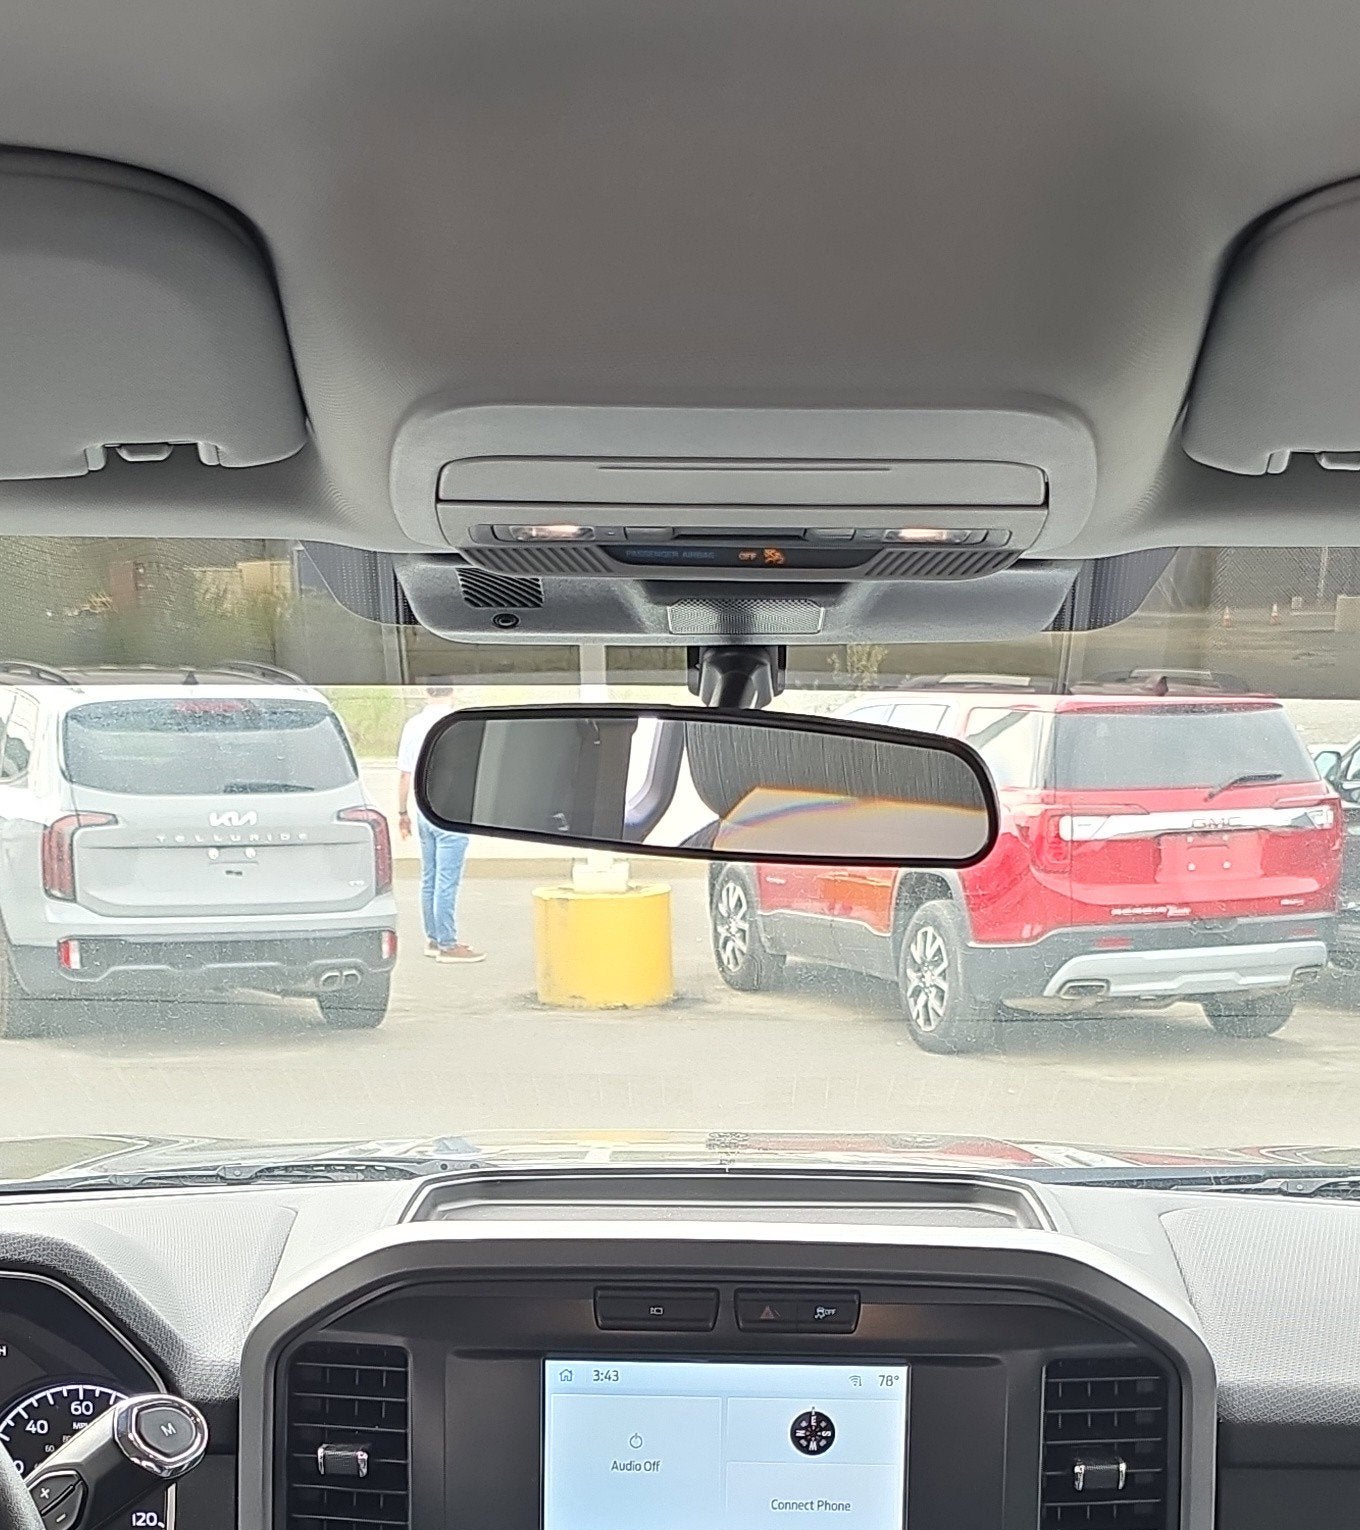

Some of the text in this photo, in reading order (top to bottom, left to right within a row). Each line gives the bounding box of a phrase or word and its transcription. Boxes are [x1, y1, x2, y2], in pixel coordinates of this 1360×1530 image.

[625, 550, 715, 559] PASSENGER AIRBAG
[738, 552, 757, 560] OFF
[156, 832, 308, 843] TELLURIDE
[592, 1369, 620, 1382] 3:43
[878, 1374, 900, 1387] 78°
[70, 1402, 94, 1416] 60
[25, 1420, 49, 1434] 40
[161, 1423, 176, 1437] M
[611, 1459, 661, 1472] Audio Off
[770, 1498, 851, 1512] Connect Phone
[132, 1512, 158, 1527] 120
